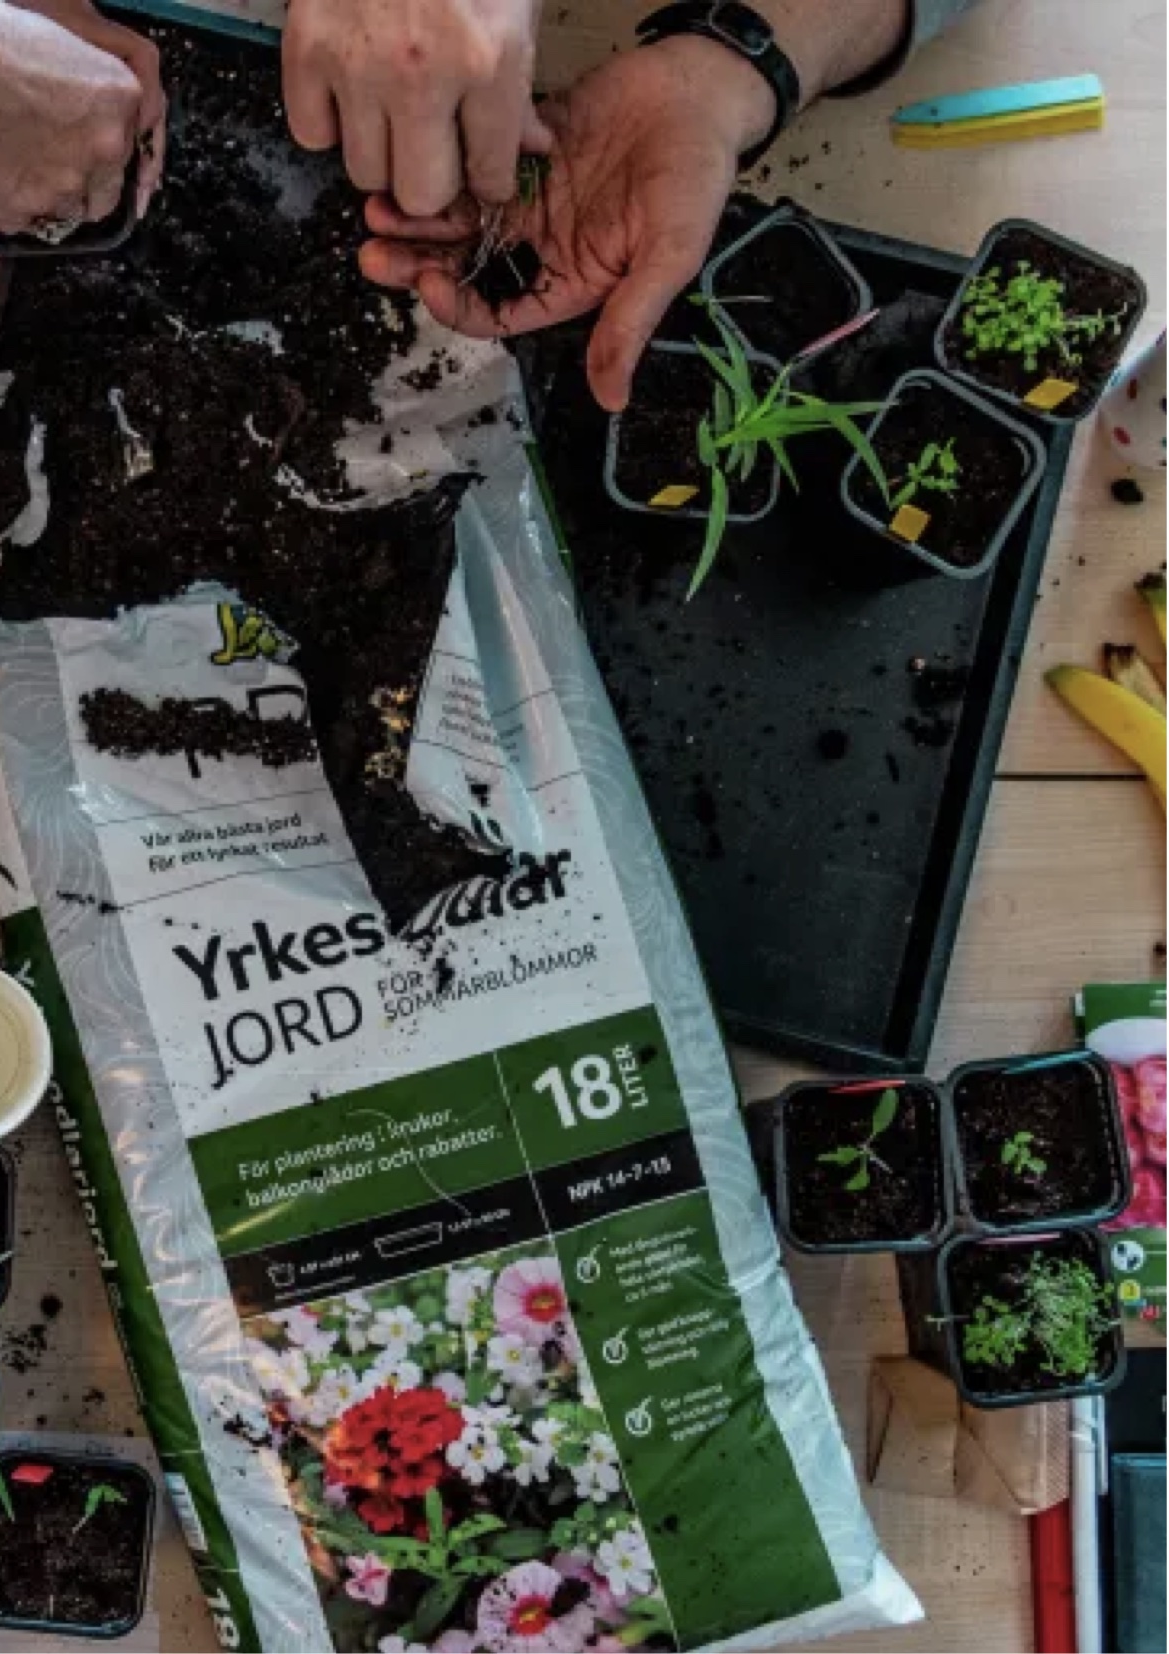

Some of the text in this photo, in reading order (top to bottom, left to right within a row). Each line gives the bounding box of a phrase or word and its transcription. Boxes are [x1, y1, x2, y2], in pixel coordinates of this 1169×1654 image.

[265, 810, 303, 834] jord
[376, 968, 424, 998] FÖR
[202, 986, 364, 1090] JORD
[531, 1053, 623, 1130] 18
[611, 1042, 649, 1110] LITER
[238, 1160, 270, 1181] För
[274, 1130, 376, 1175] plantering
[244, 1158, 374, 1208] balkonglådor
[378, 1146, 415, 1172] och
[566, 1176, 604, 1203] NPK
